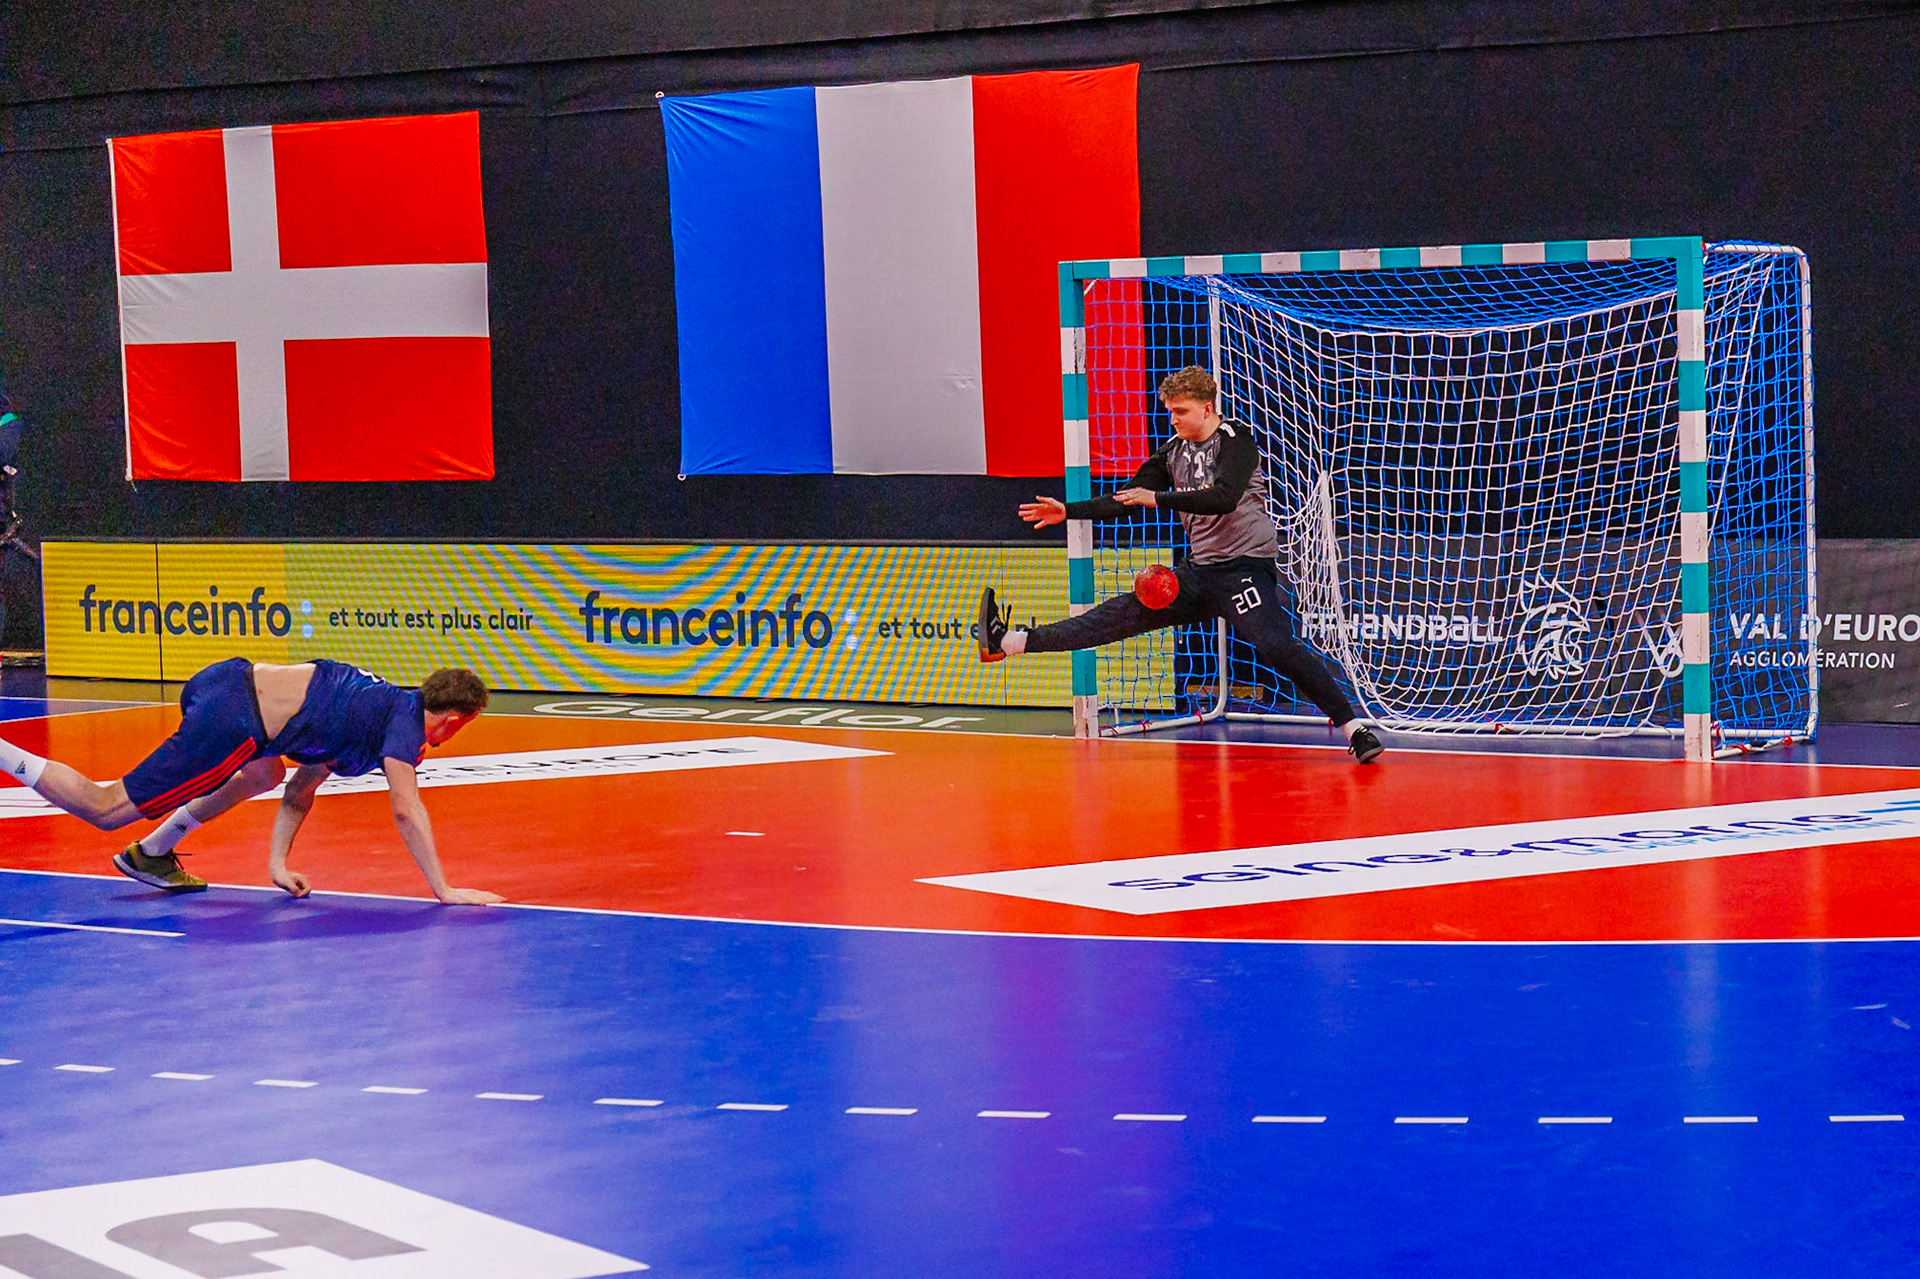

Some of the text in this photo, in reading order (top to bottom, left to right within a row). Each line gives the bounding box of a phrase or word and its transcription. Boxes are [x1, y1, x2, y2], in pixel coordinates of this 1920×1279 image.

[1231, 586, 1262, 615] 20
[329, 608, 349, 627] et
[355, 608, 399, 628] tout
[405, 609, 434, 629] est
[441, 607, 482, 635] plus
[488, 608, 533, 630] clair
[878, 618, 902, 639] et
[910, 618, 962, 640] tout
[1730, 613, 1787, 640] VAL
[533, 700, 985, 728] Gerflor
